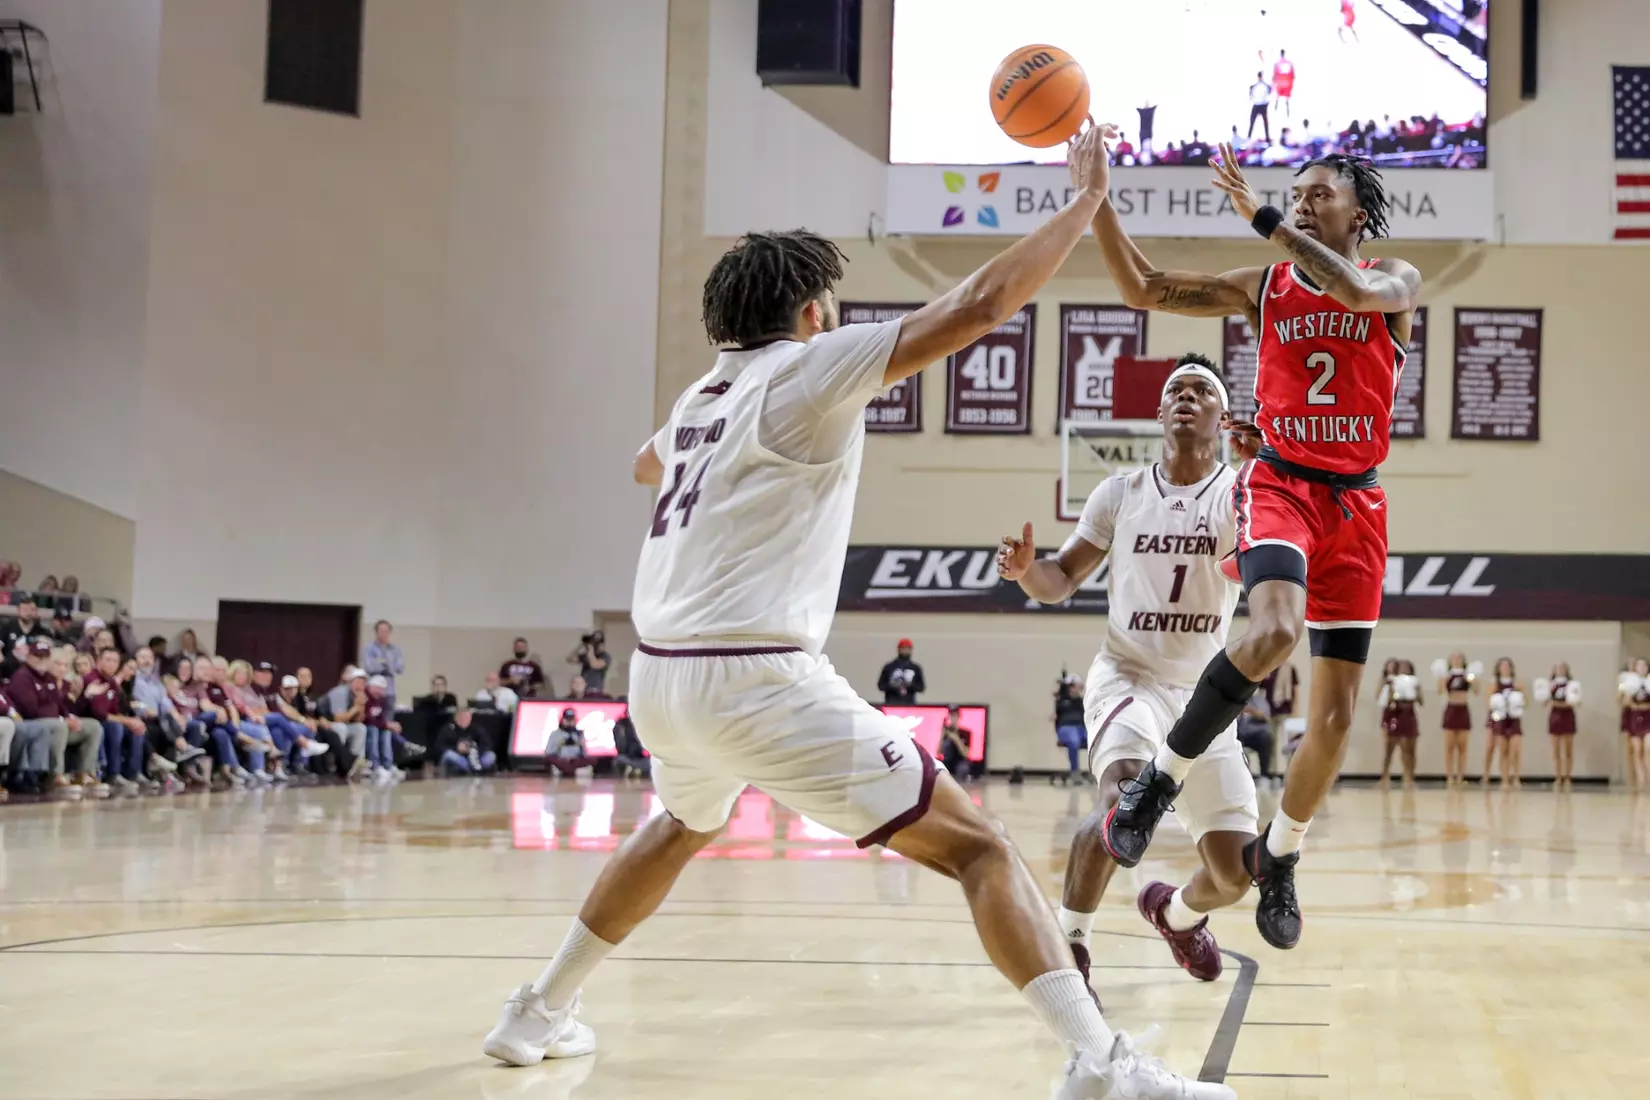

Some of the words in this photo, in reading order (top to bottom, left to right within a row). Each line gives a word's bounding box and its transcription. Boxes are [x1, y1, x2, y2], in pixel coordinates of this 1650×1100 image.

[1016, 187, 1156, 215] BAPIST
[1168, 189, 1293, 217] HEATH
[1273, 312, 1370, 345] WESTERN
[961, 344, 1016, 390] 40
[1305, 352, 1337, 406] 2
[1133, 534, 1218, 556] EASTERN
[869, 549, 1001, 589] EKU
[1169, 564, 1188, 603] 1
